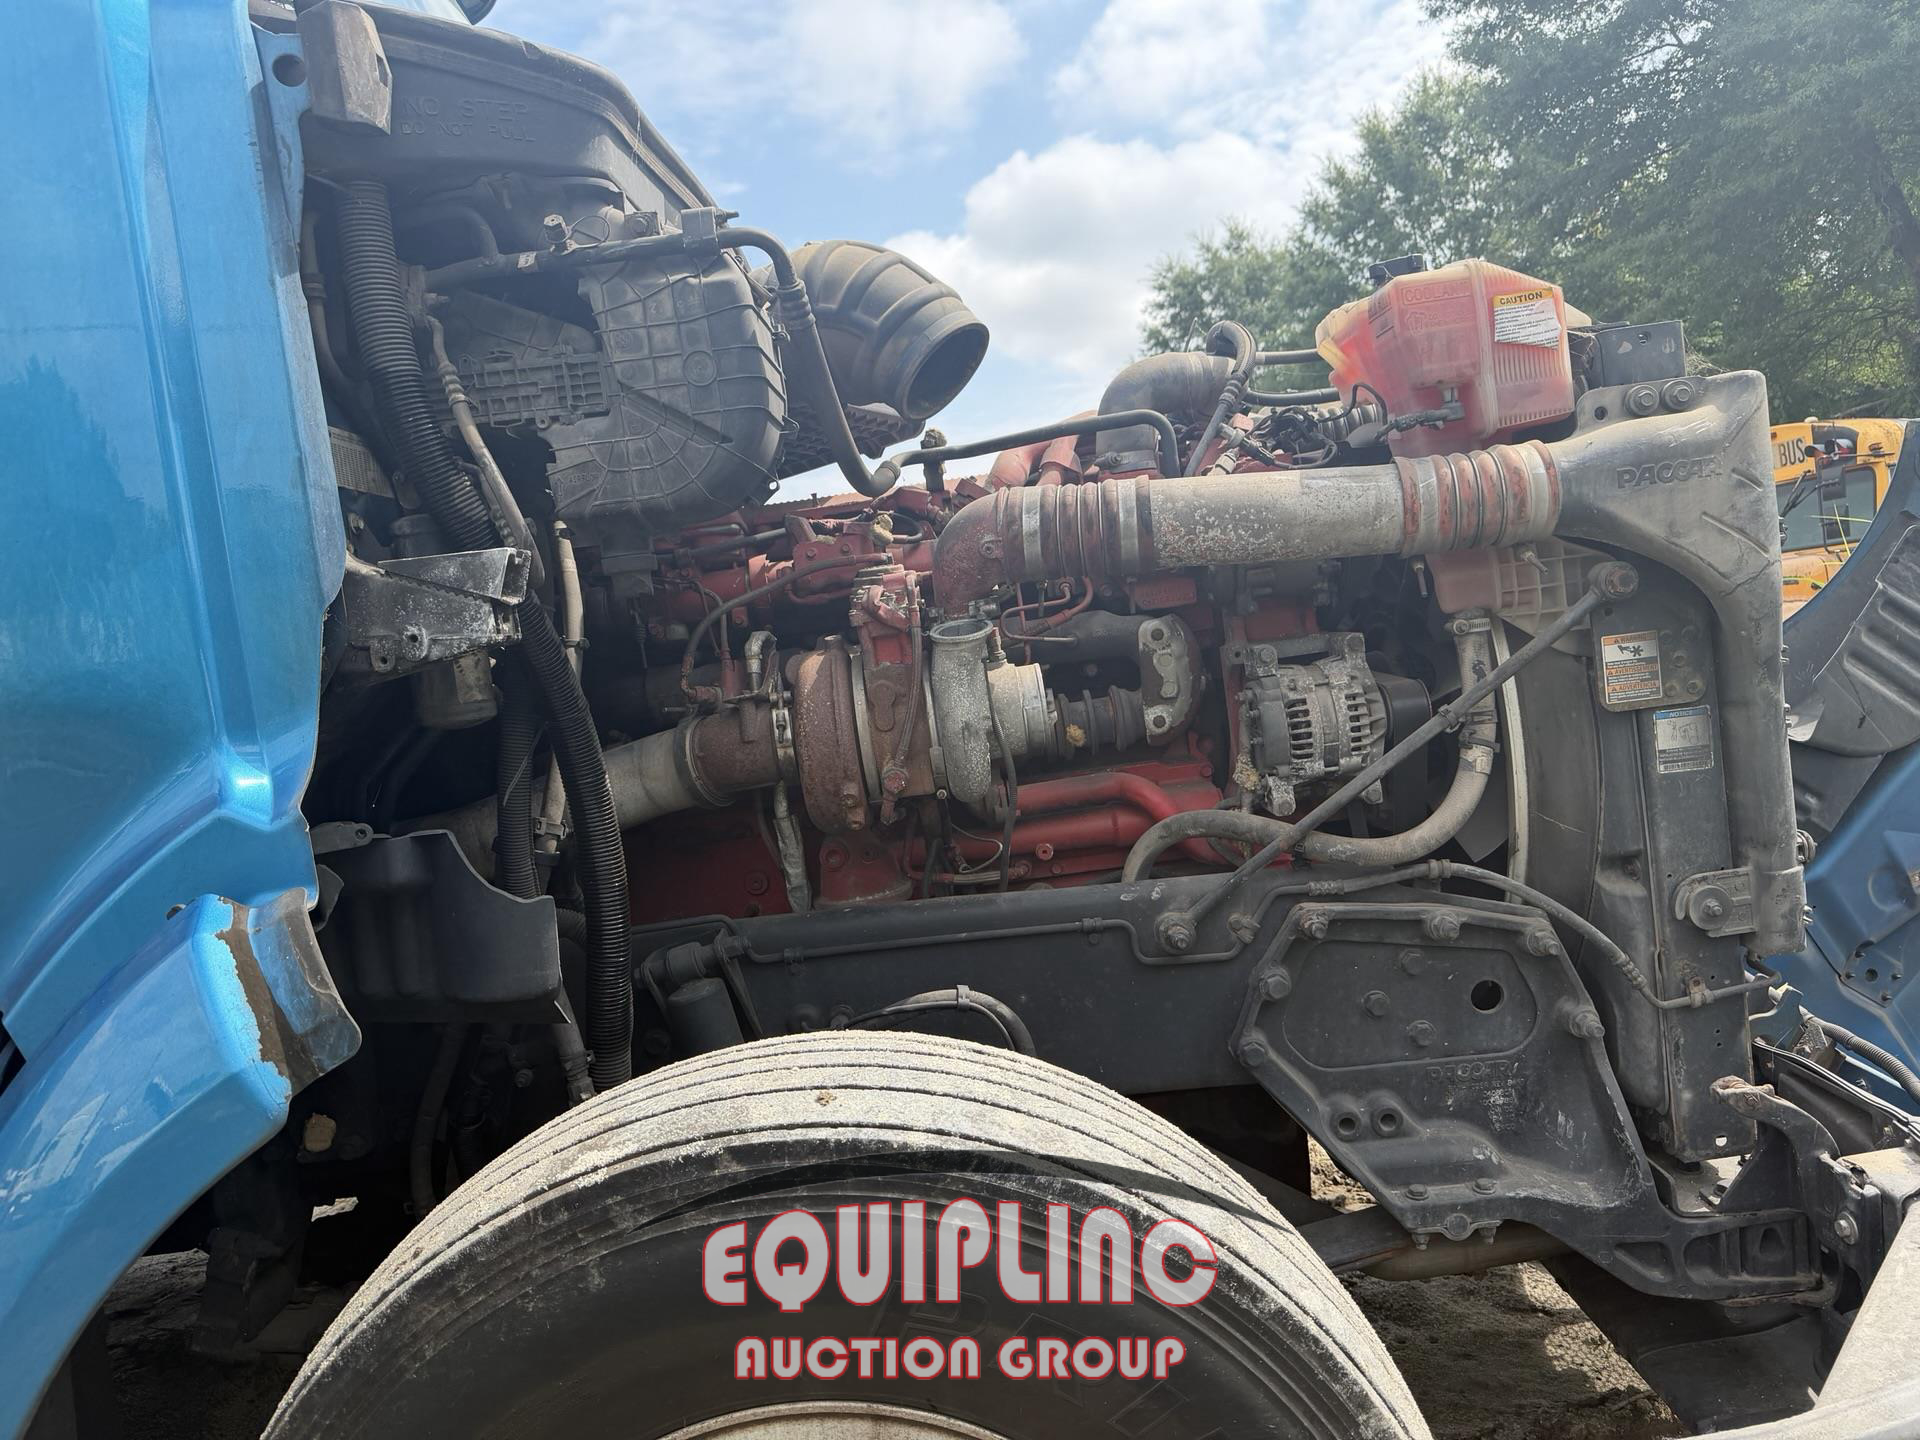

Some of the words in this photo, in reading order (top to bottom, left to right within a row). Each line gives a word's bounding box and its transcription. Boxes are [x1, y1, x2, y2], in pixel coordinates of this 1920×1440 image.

[401, 96, 440, 117] NO
[457, 98, 529, 121] STEP
[439, 119, 473, 137] NOT
[1499, 291, 1543, 305] CAUTION
[1779, 437, 1805, 467] BUS
[1616, 455, 1723, 489] PACCAR
[1669, 710, 1693, 718] NOTICE
